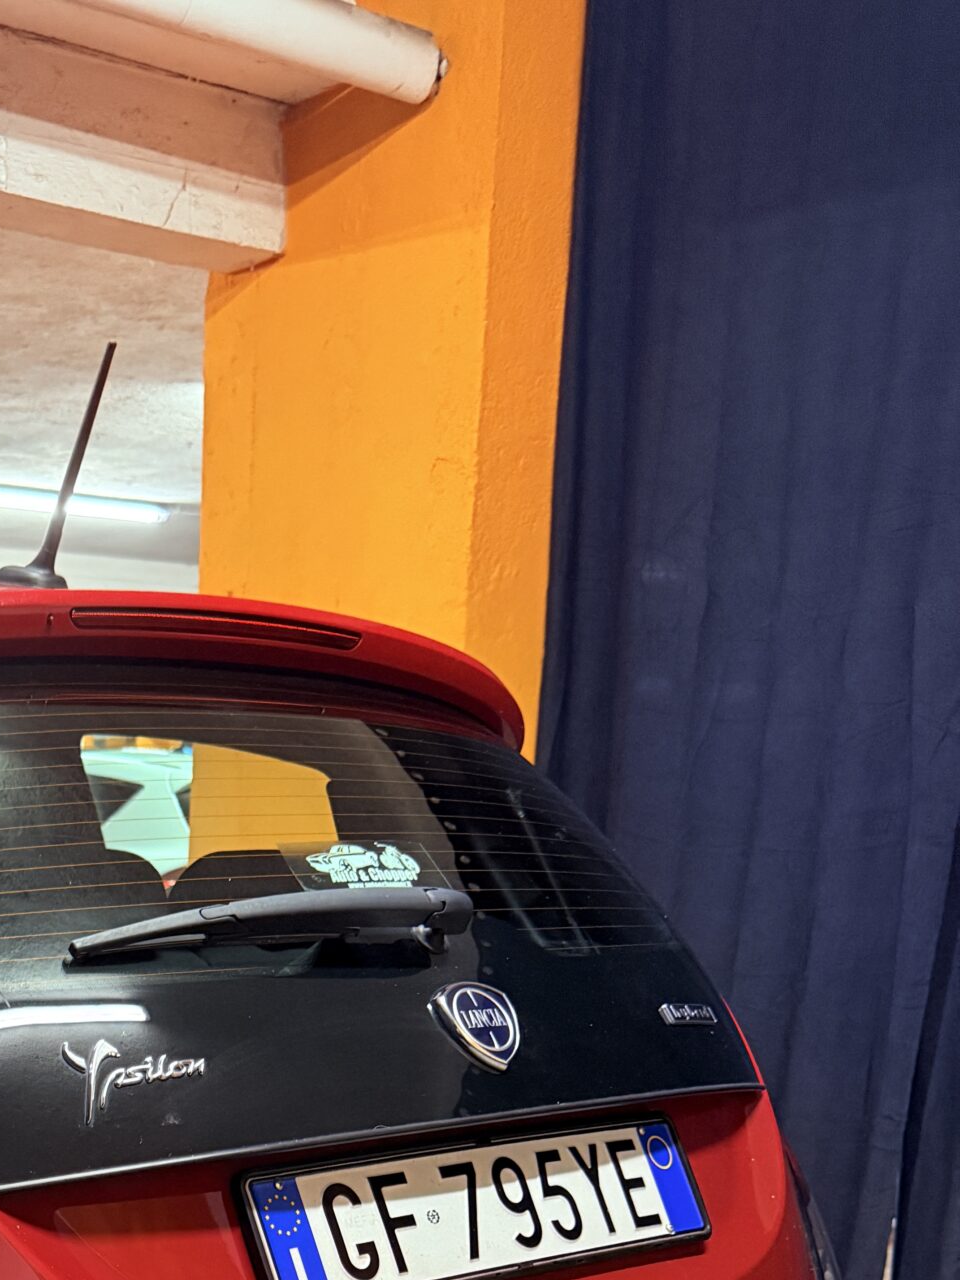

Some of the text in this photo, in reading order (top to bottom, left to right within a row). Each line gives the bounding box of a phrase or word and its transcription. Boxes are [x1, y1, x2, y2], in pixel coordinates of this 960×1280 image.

[329, 867, 418, 883] Auto & Chopper
[460, 1008, 507, 1028] LANCIA
[61, 1039, 205, 1126] Ypsilon
[322, 1171, 417, 1280] GF
[439, 1138, 662, 1261] 795YE
